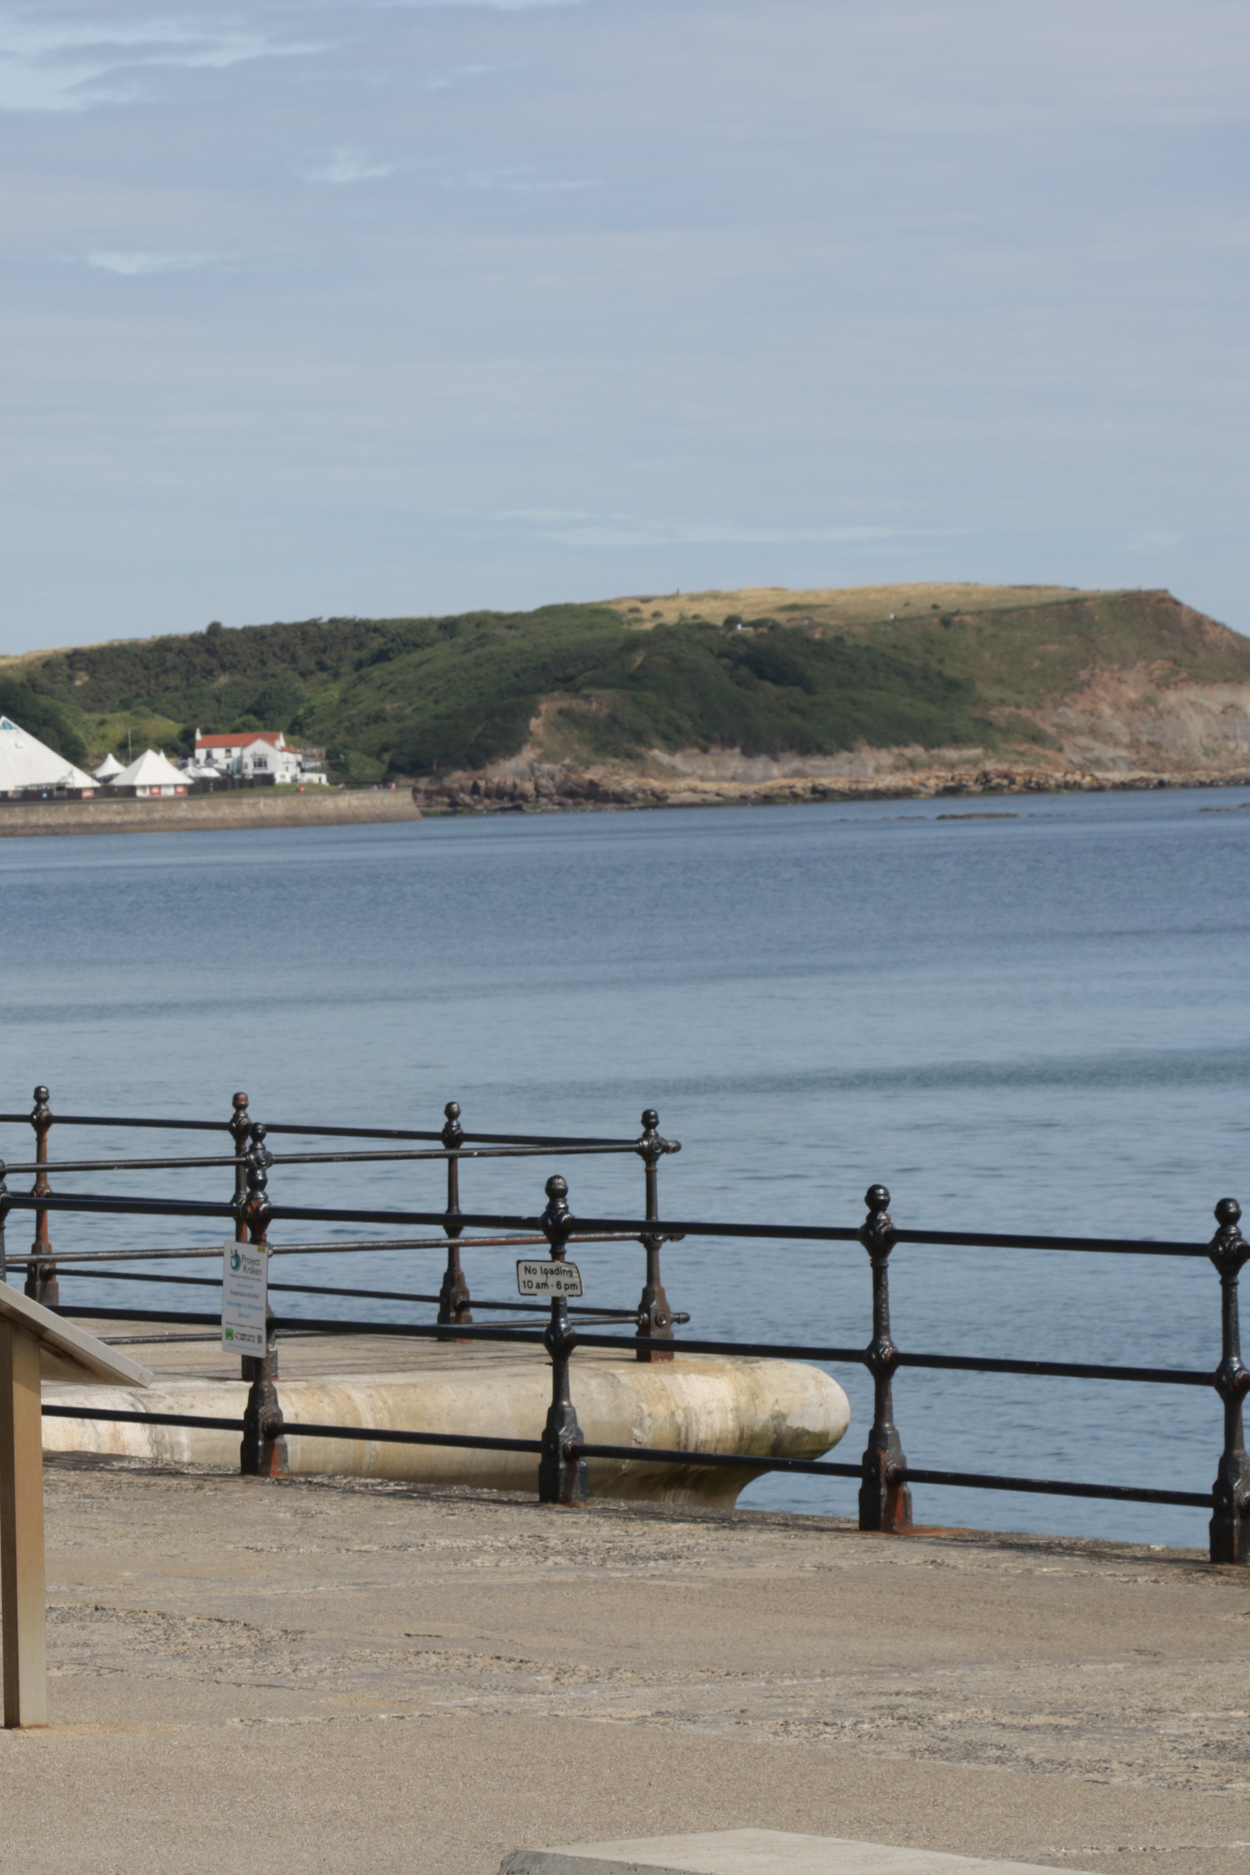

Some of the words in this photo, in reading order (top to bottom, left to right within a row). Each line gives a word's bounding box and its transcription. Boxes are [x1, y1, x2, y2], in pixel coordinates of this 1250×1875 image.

[242, 1255, 260, 1267] Project
[243, 1265, 262, 1275] Kraken
[524, 1266, 537, 1275] No
[540, 1266, 573, 1277] loading
[523, 1280, 533, 1289] 10
[536, 1282, 548, 1290] am
[556, 1281, 562, 1290] 6
[564, 1283, 578, 1291] pm
